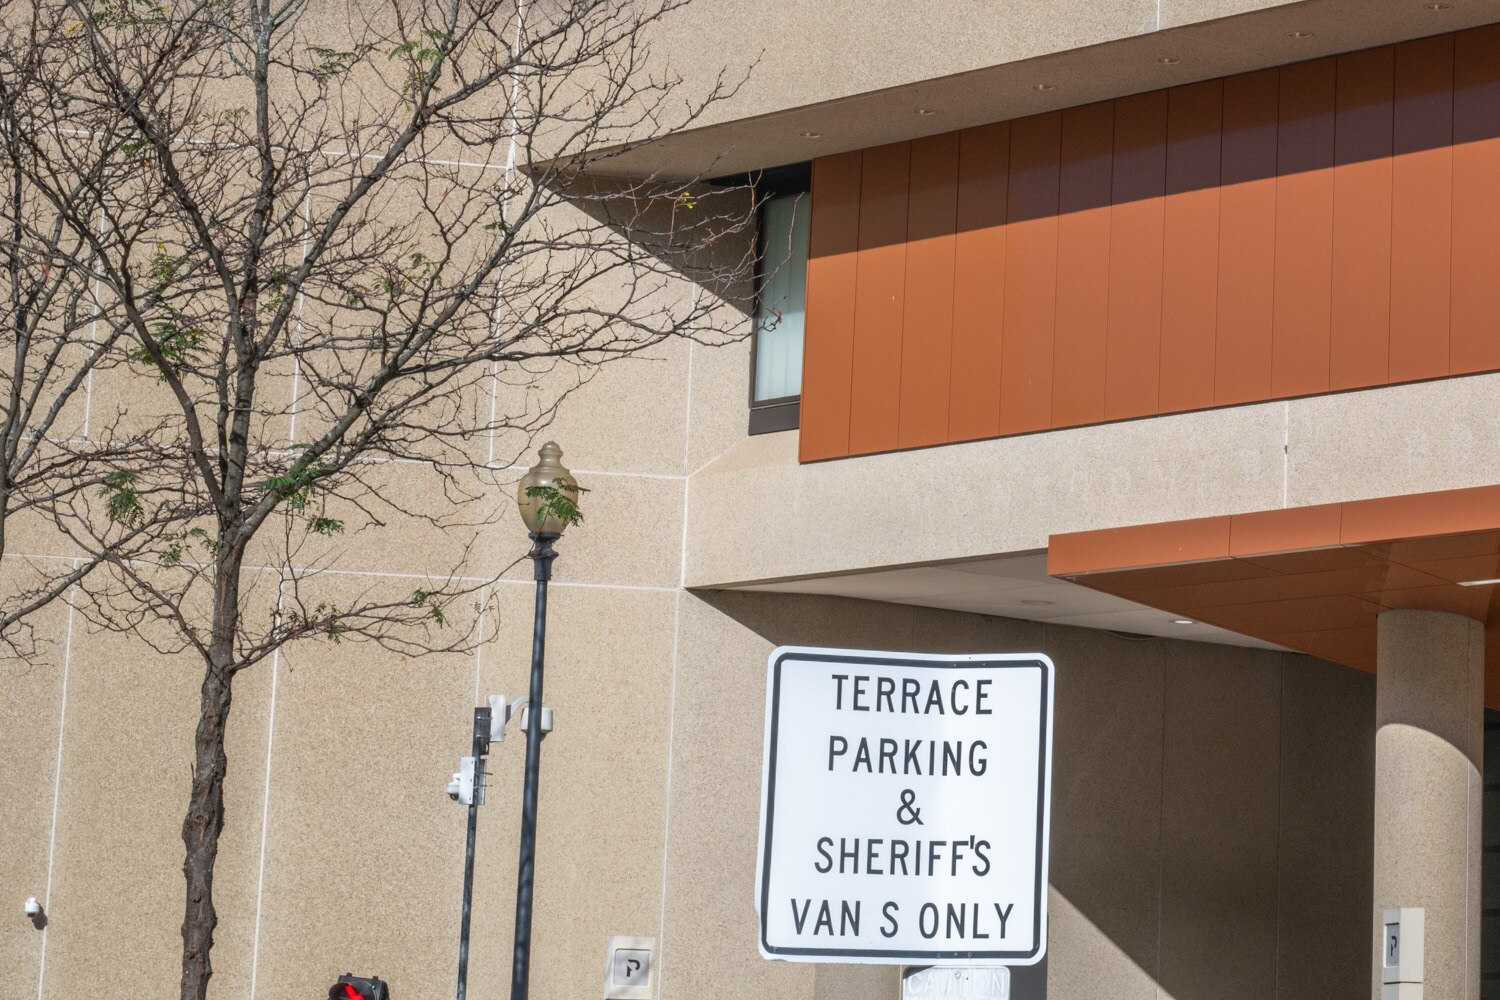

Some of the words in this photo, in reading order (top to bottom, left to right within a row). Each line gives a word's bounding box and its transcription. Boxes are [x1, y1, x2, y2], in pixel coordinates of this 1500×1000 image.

[831, 674, 993, 716] TERRACE
[828, 735, 988, 777] PARKING
[896, 788, 924, 826] &
[814, 835, 991, 877] SHERIFF'S
[918, 902, 1014, 939] ONLY
